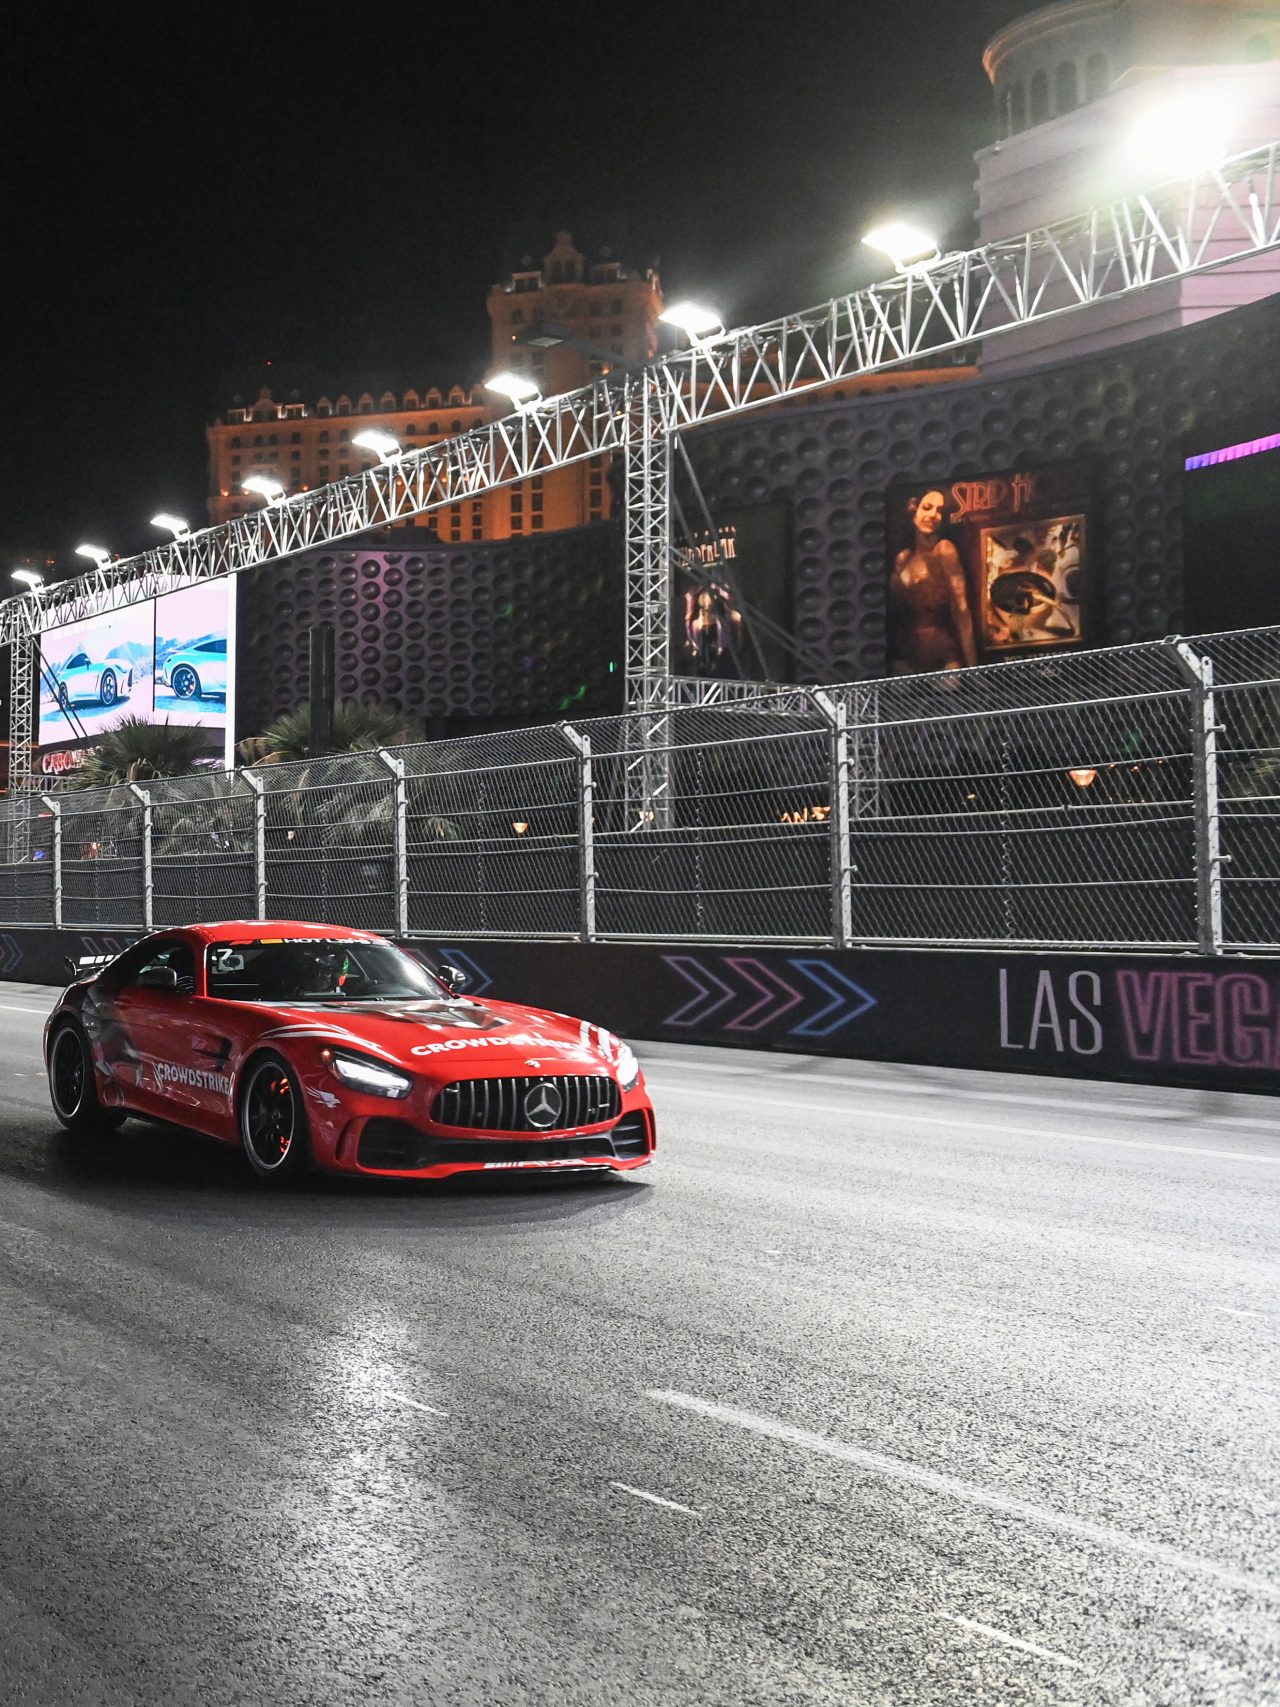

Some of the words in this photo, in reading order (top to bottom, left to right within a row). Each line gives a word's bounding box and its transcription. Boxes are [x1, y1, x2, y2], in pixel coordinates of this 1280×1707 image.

[998, 968, 1103, 1055] LAS
[1116, 970, 1280, 1069] VEG
[157, 1063, 230, 1095] CROWDSTRIKE
